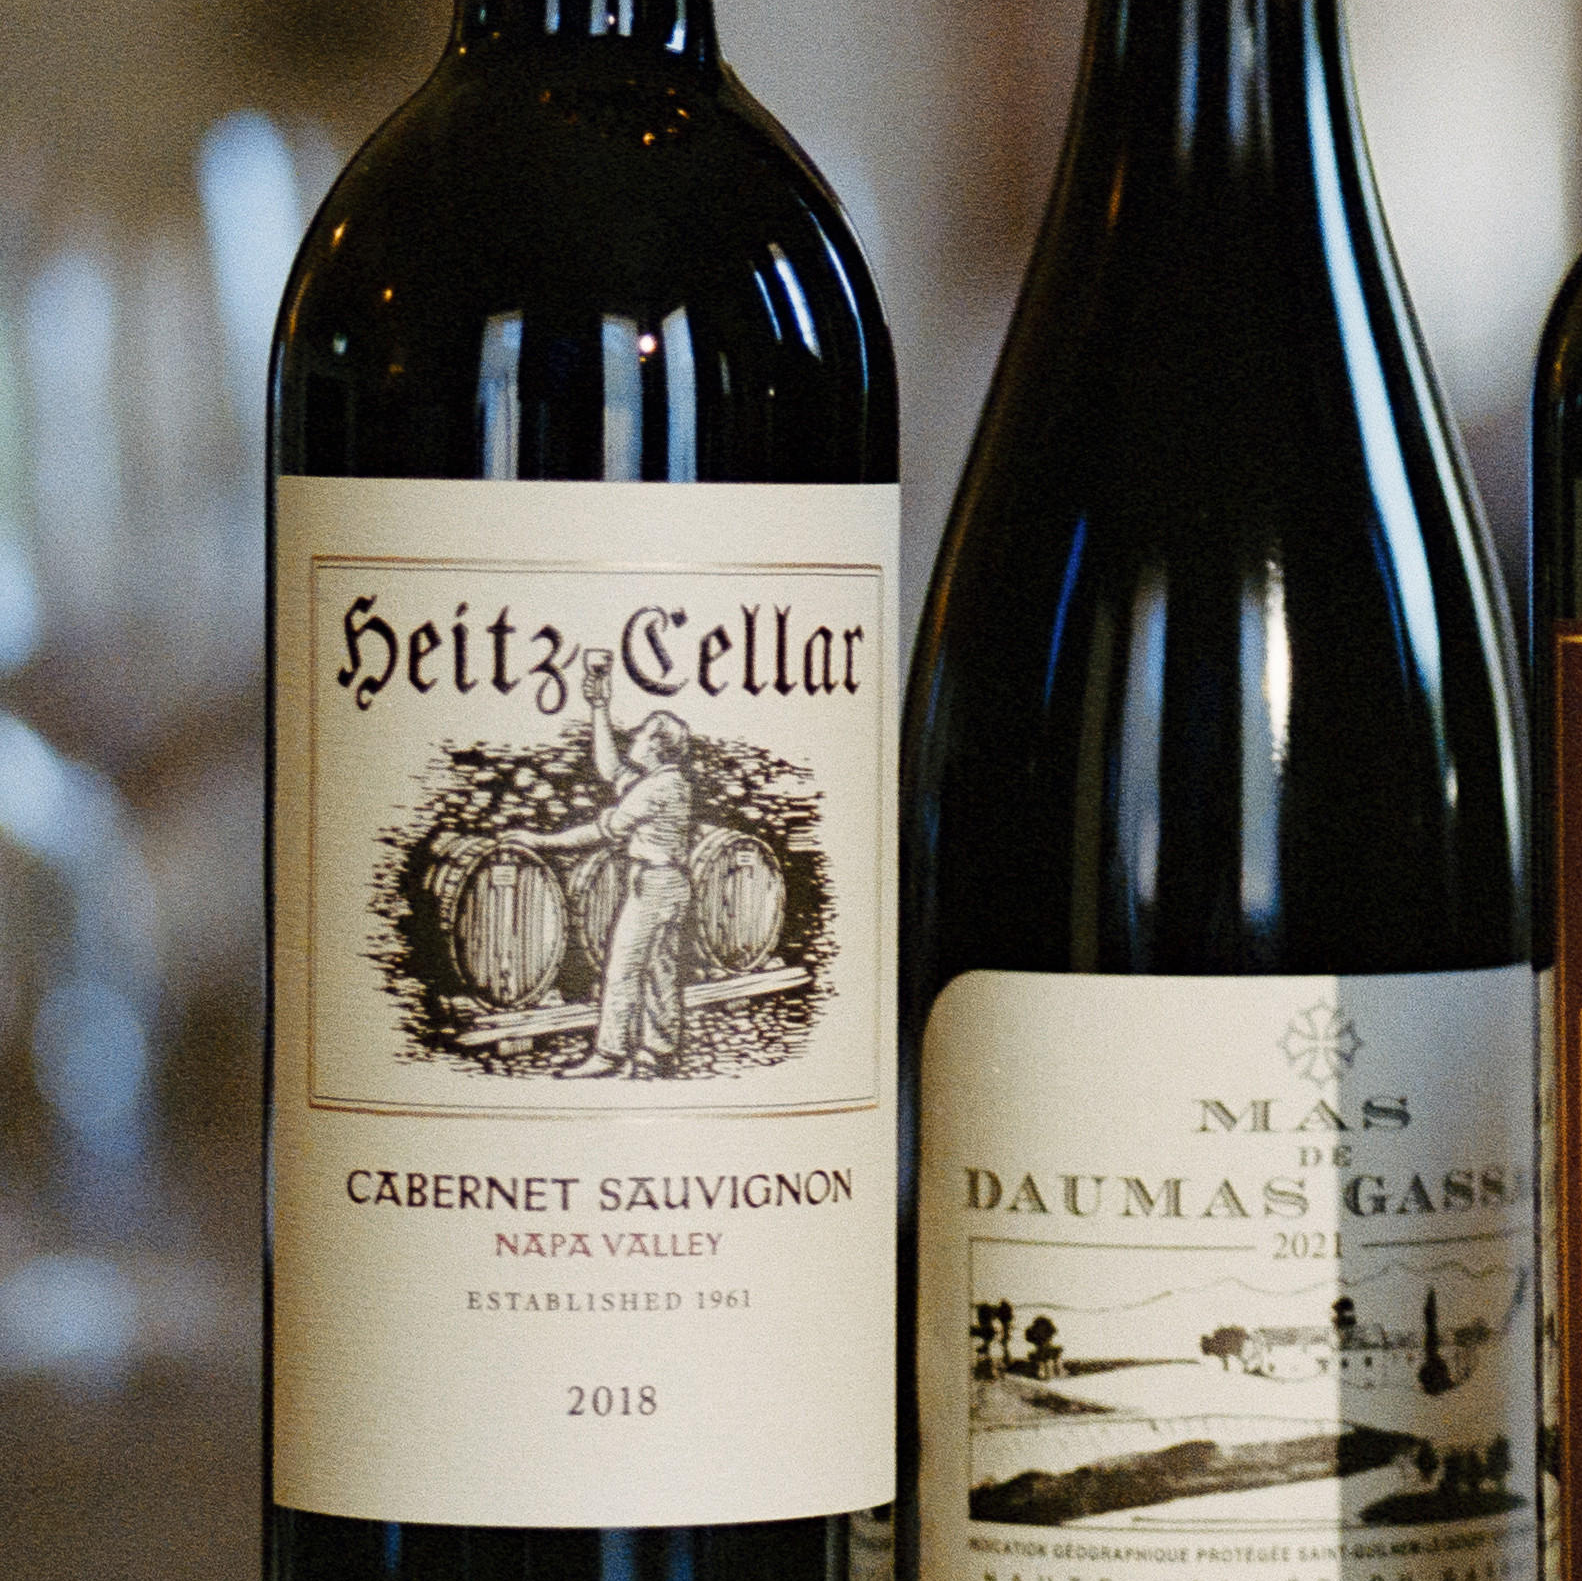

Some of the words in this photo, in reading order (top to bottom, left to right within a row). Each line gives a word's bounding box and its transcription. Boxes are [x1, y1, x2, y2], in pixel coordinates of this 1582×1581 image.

[336, 594, 581, 714] Heitz
[620, 603, 864, 698] Cellar
[1195, 1095, 1412, 1134] MAS
[1299, 1146, 1353, 1169] DE
[346, 1169, 580, 1212] CABERNET
[598, 1167, 854, 1212] SAUVIGNON
[963, 1166, 1311, 1218] DAUMAS
[495, 1232, 594, 1258] NAPA
[605, 1232, 724, 1258] VALLEY
[1271, 1231, 1345, 1260] 2021
[466, 1290, 683, 1313] ESTABLISHED
[696, 1289, 753, 1311] 1961
[567, 1385, 658, 1417] 2018
